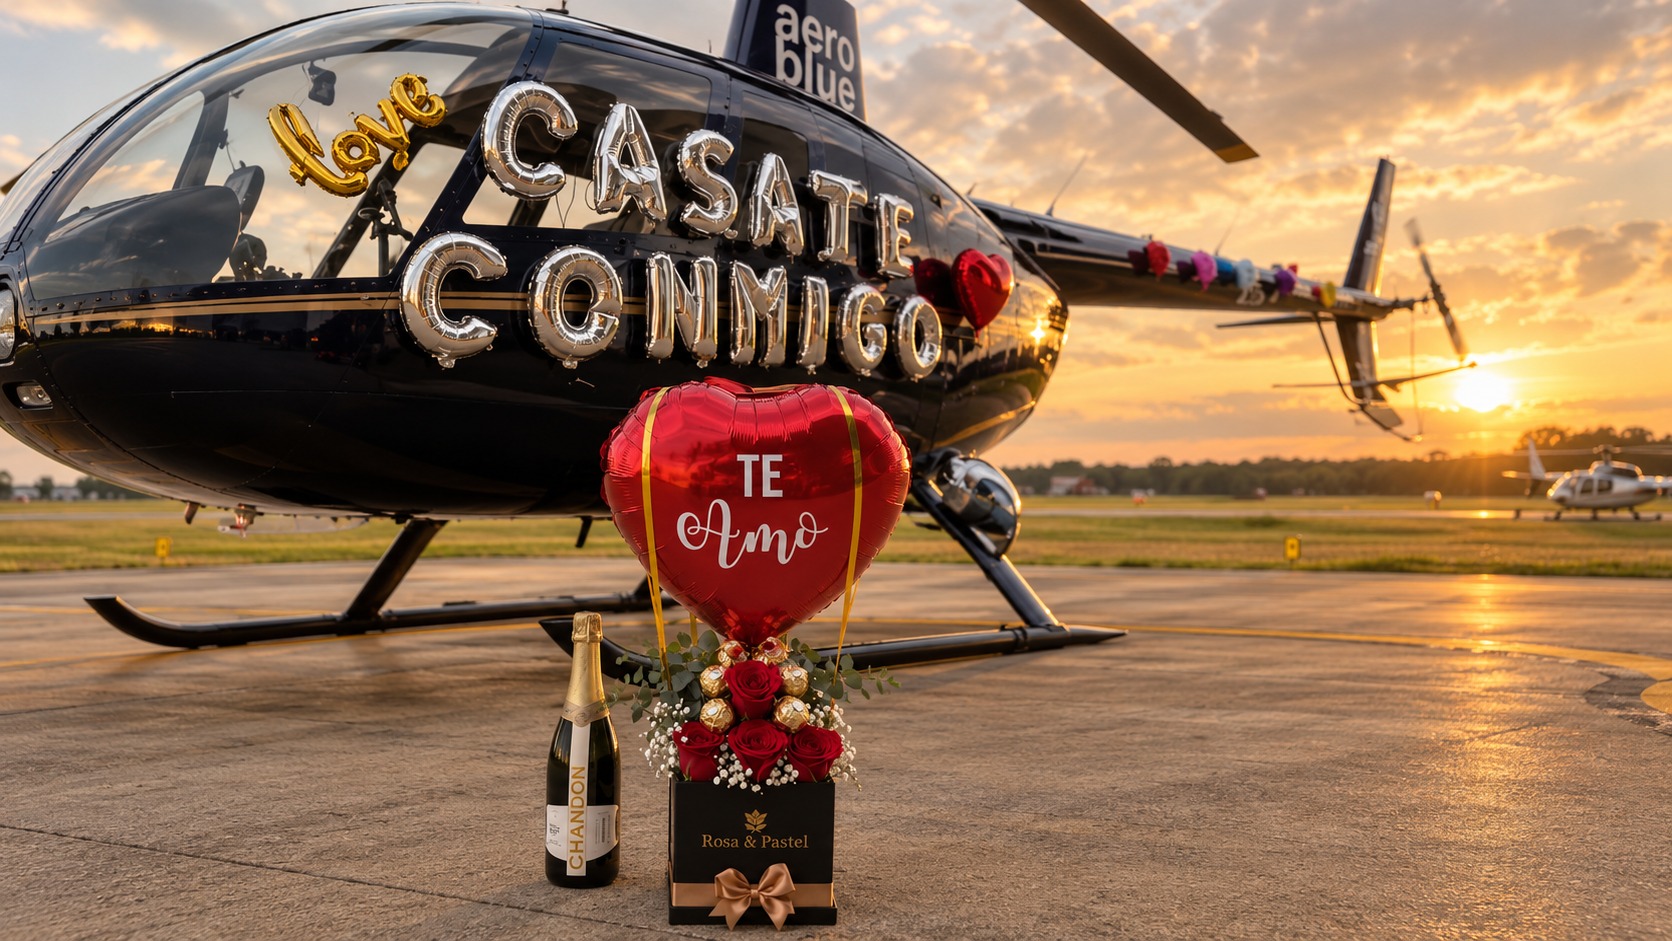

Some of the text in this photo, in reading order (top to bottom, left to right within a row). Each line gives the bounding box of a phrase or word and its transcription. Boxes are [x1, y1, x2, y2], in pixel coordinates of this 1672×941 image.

[775, 4, 855, 72] aero
[775, 35, 856, 112] blue
[480, 80, 914, 279] CASATE
[399, 231, 943, 382] CONMIGO
[736, 454, 784, 497] TE
[676, 498, 829, 569] Amo
[568, 766, 586, 870] CHANDON
[701, 834, 809, 848] Rosa & Pastel
